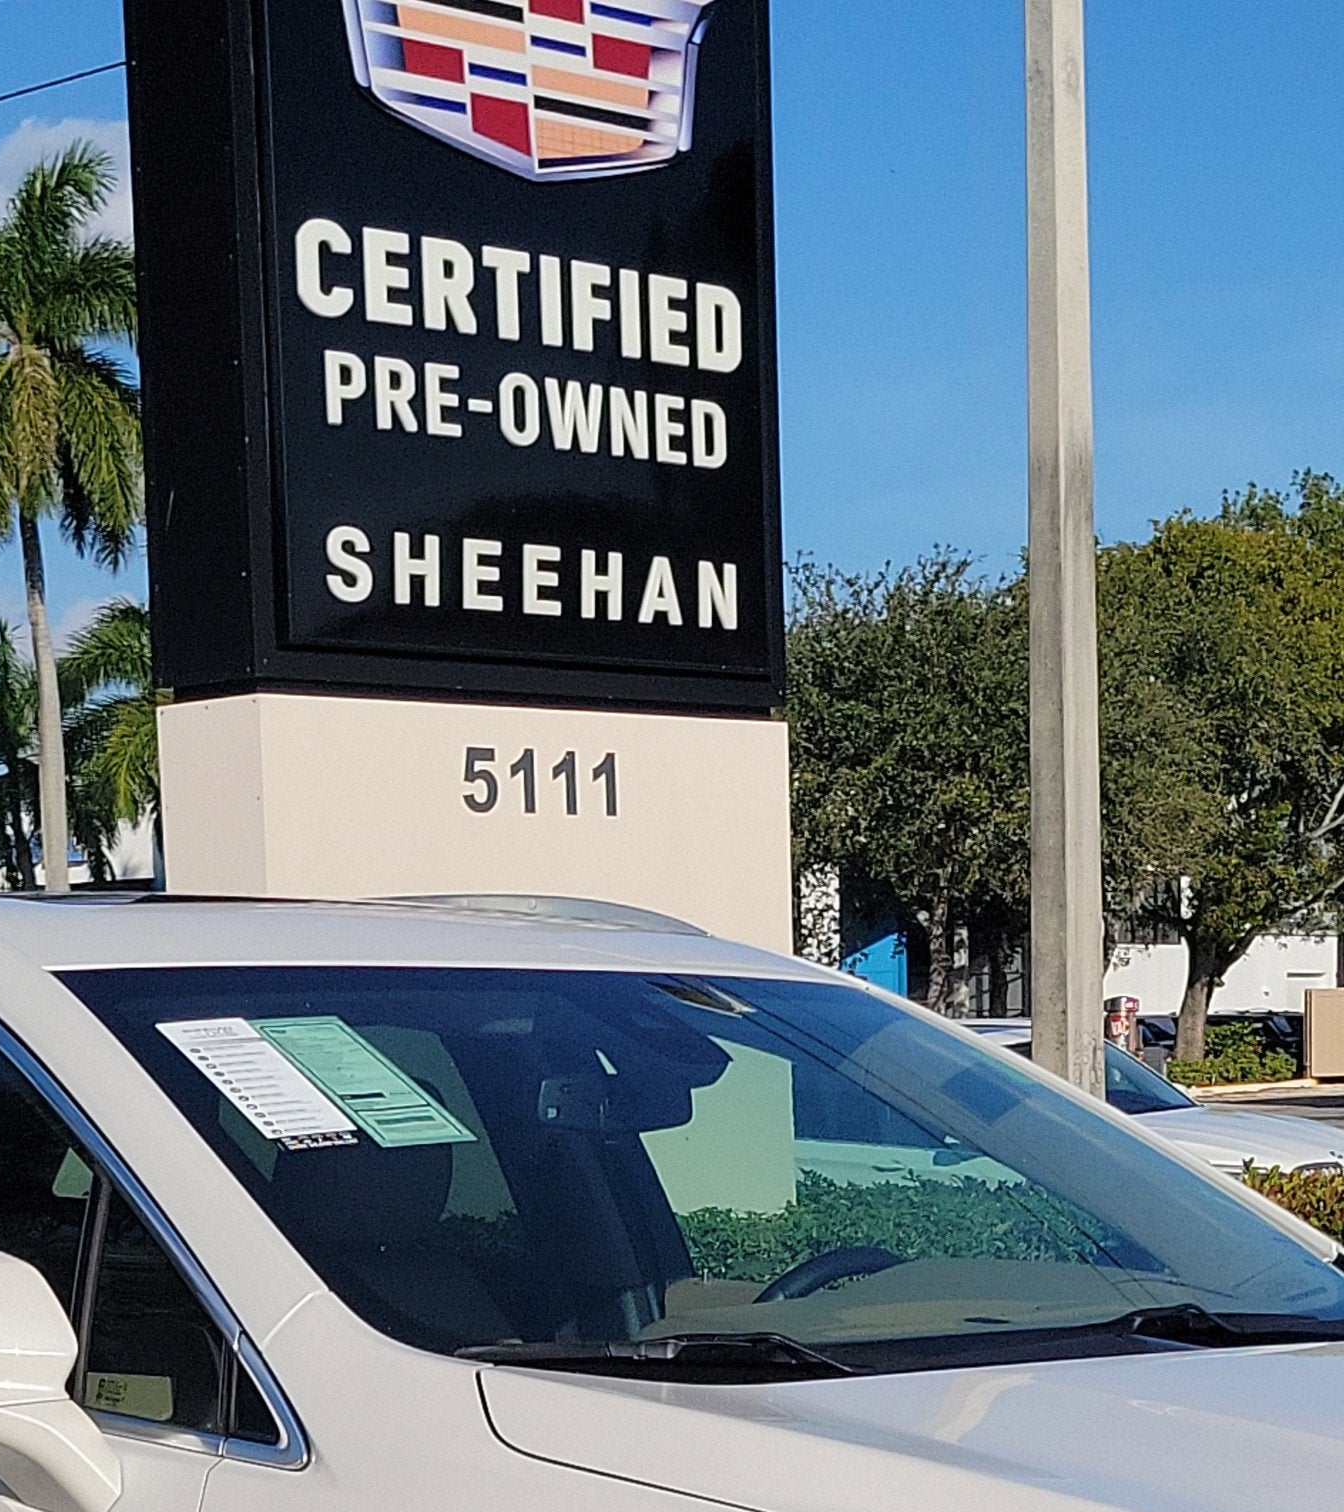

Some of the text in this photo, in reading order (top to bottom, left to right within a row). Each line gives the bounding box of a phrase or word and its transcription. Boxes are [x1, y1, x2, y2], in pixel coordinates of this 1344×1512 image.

[295, 217, 743, 374] CERTIFIED
[323, 348, 728, 470] PRE-OWNED
[325, 524, 739, 631] SHEEHAN
[461, 746, 619, 818] 5111
